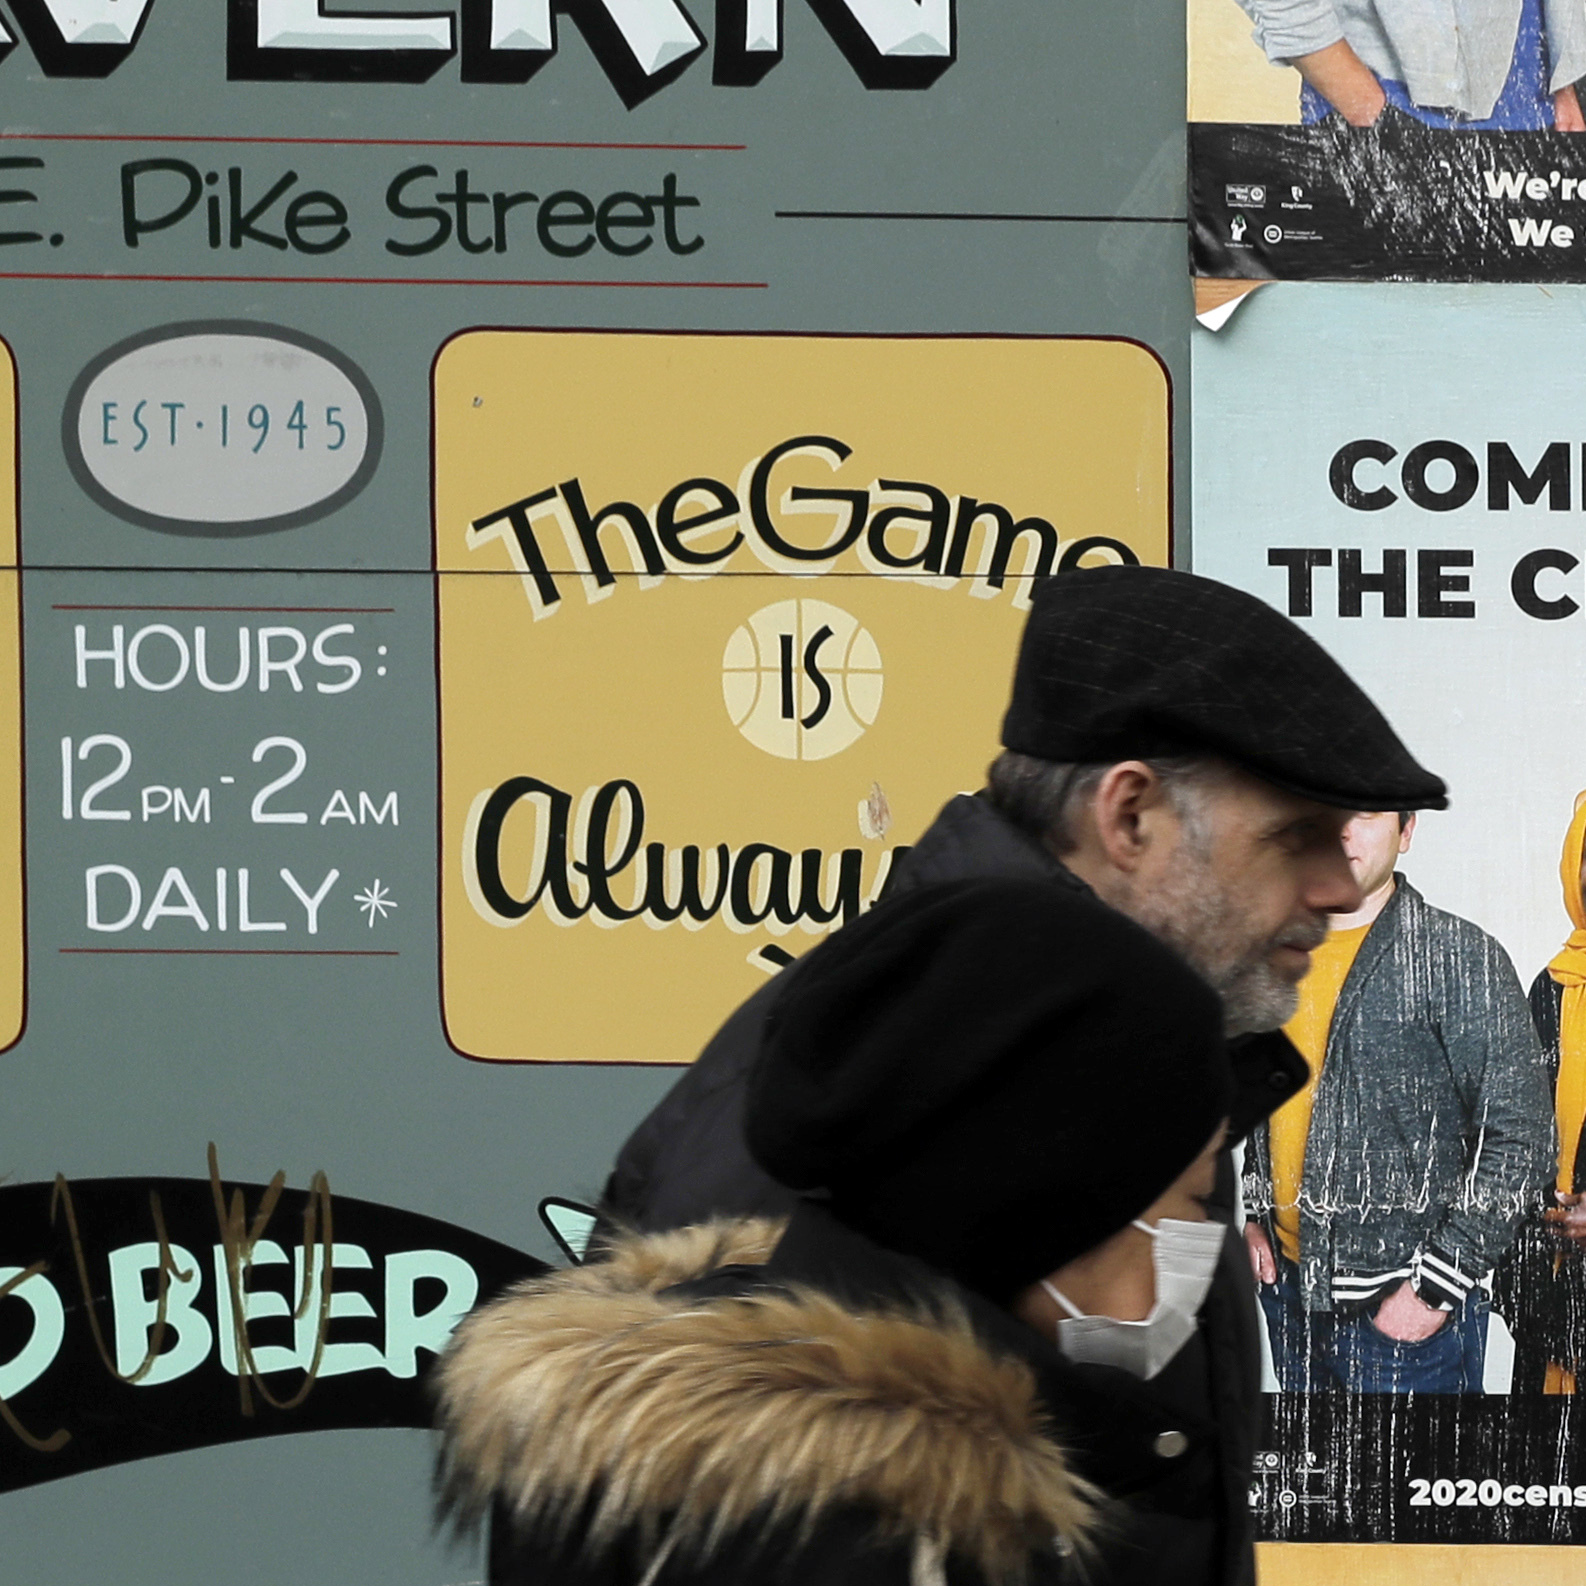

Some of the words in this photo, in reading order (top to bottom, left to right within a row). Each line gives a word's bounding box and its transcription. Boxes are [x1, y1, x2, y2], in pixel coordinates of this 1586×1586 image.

[121, 158, 351, 256] Pike
[385, 164, 705, 258] Street
[1508, 218, 1575, 250] We
[1267, 548, 1474, 618] THE
[75, 624, 387, 694] HOURS:
[781, 634, 833, 730] IS
[108, 1240, 479, 1386] BEER
